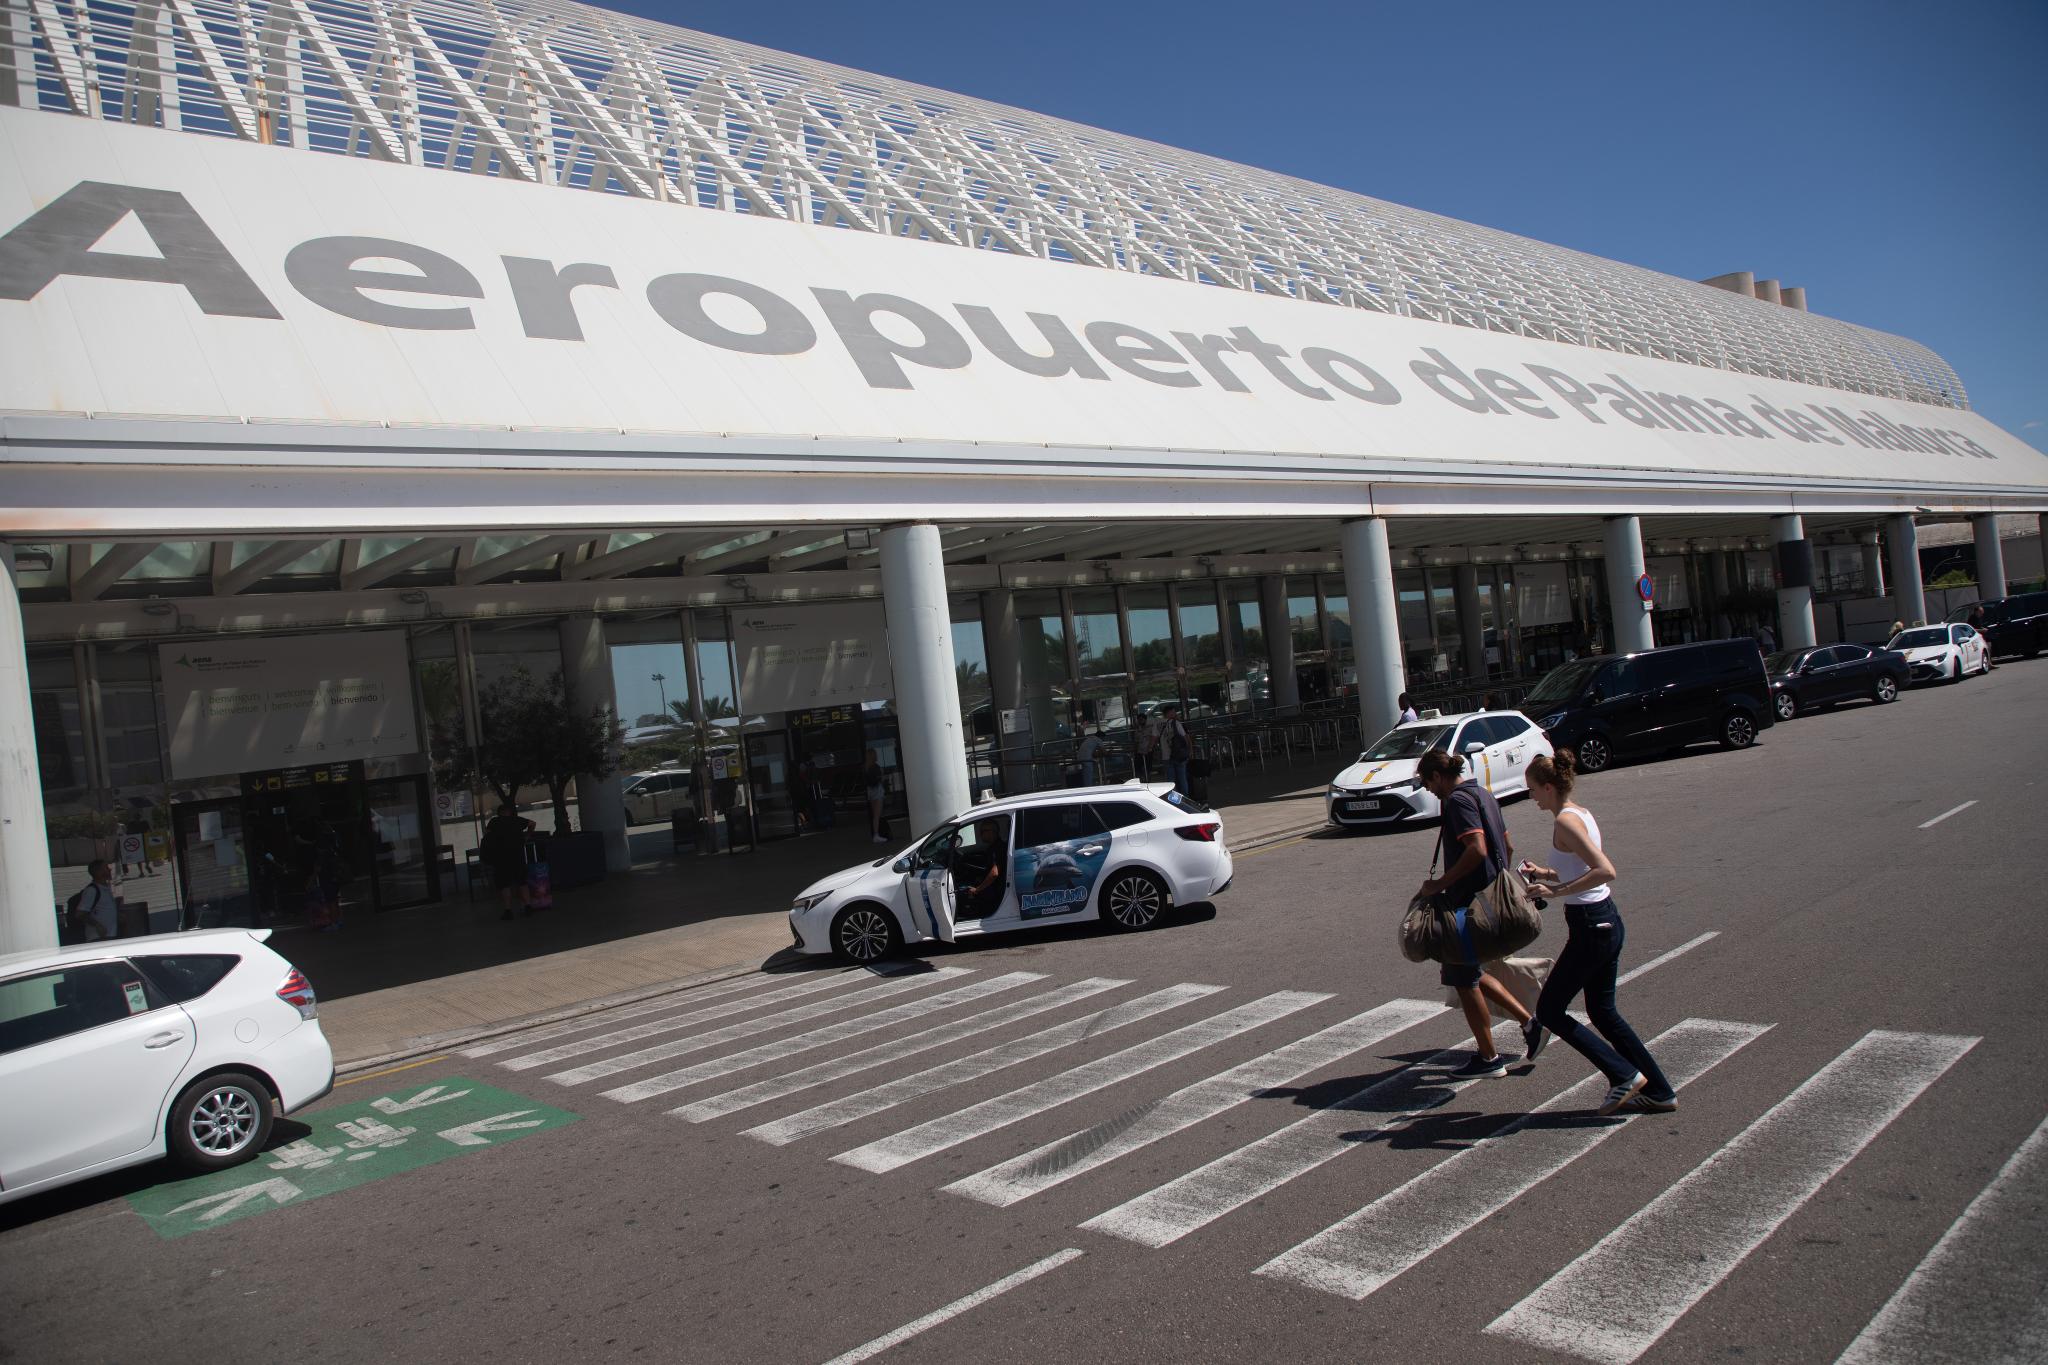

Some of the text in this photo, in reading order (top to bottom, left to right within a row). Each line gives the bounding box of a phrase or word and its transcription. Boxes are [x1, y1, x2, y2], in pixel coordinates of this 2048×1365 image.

[0, 180, 1999, 460] Aeropuerto de Palma de Mallorca
